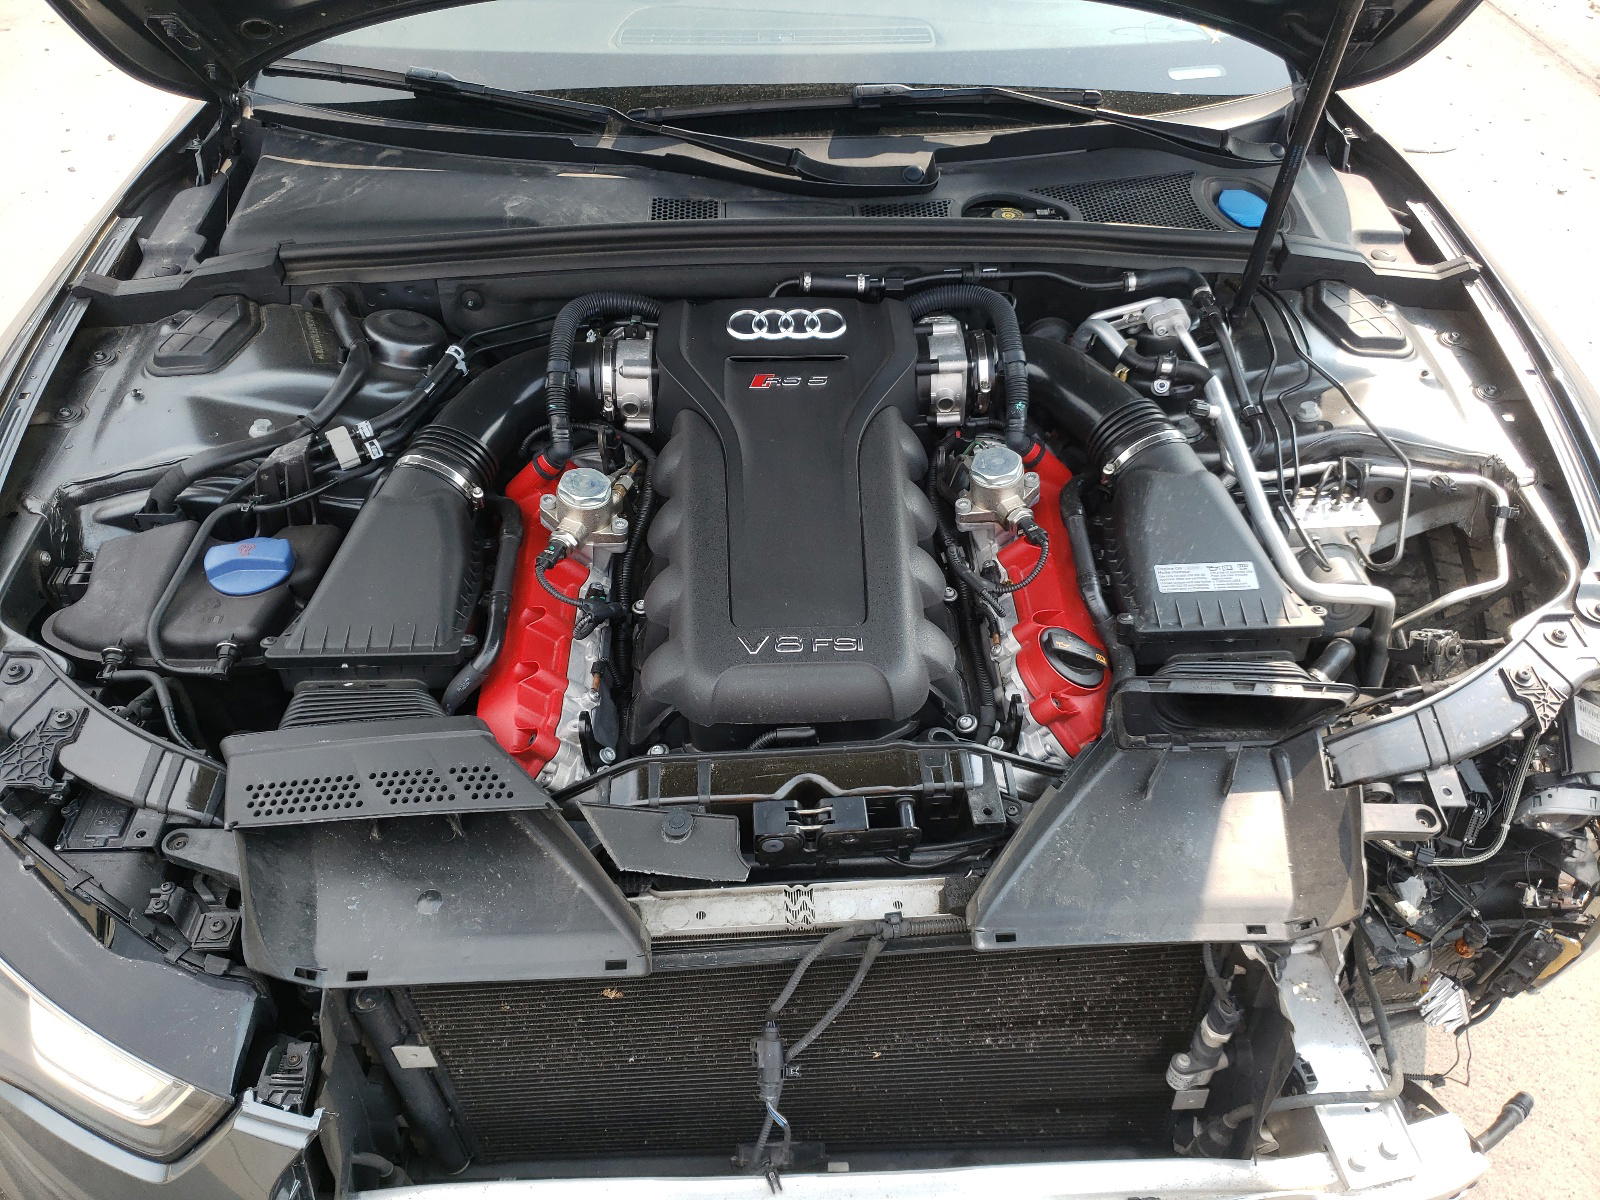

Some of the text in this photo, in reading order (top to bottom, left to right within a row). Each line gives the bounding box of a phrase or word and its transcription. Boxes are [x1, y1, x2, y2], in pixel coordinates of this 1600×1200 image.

[749, 373, 828, 388] RS 5
[737, 635, 864, 654] V8 FSI
